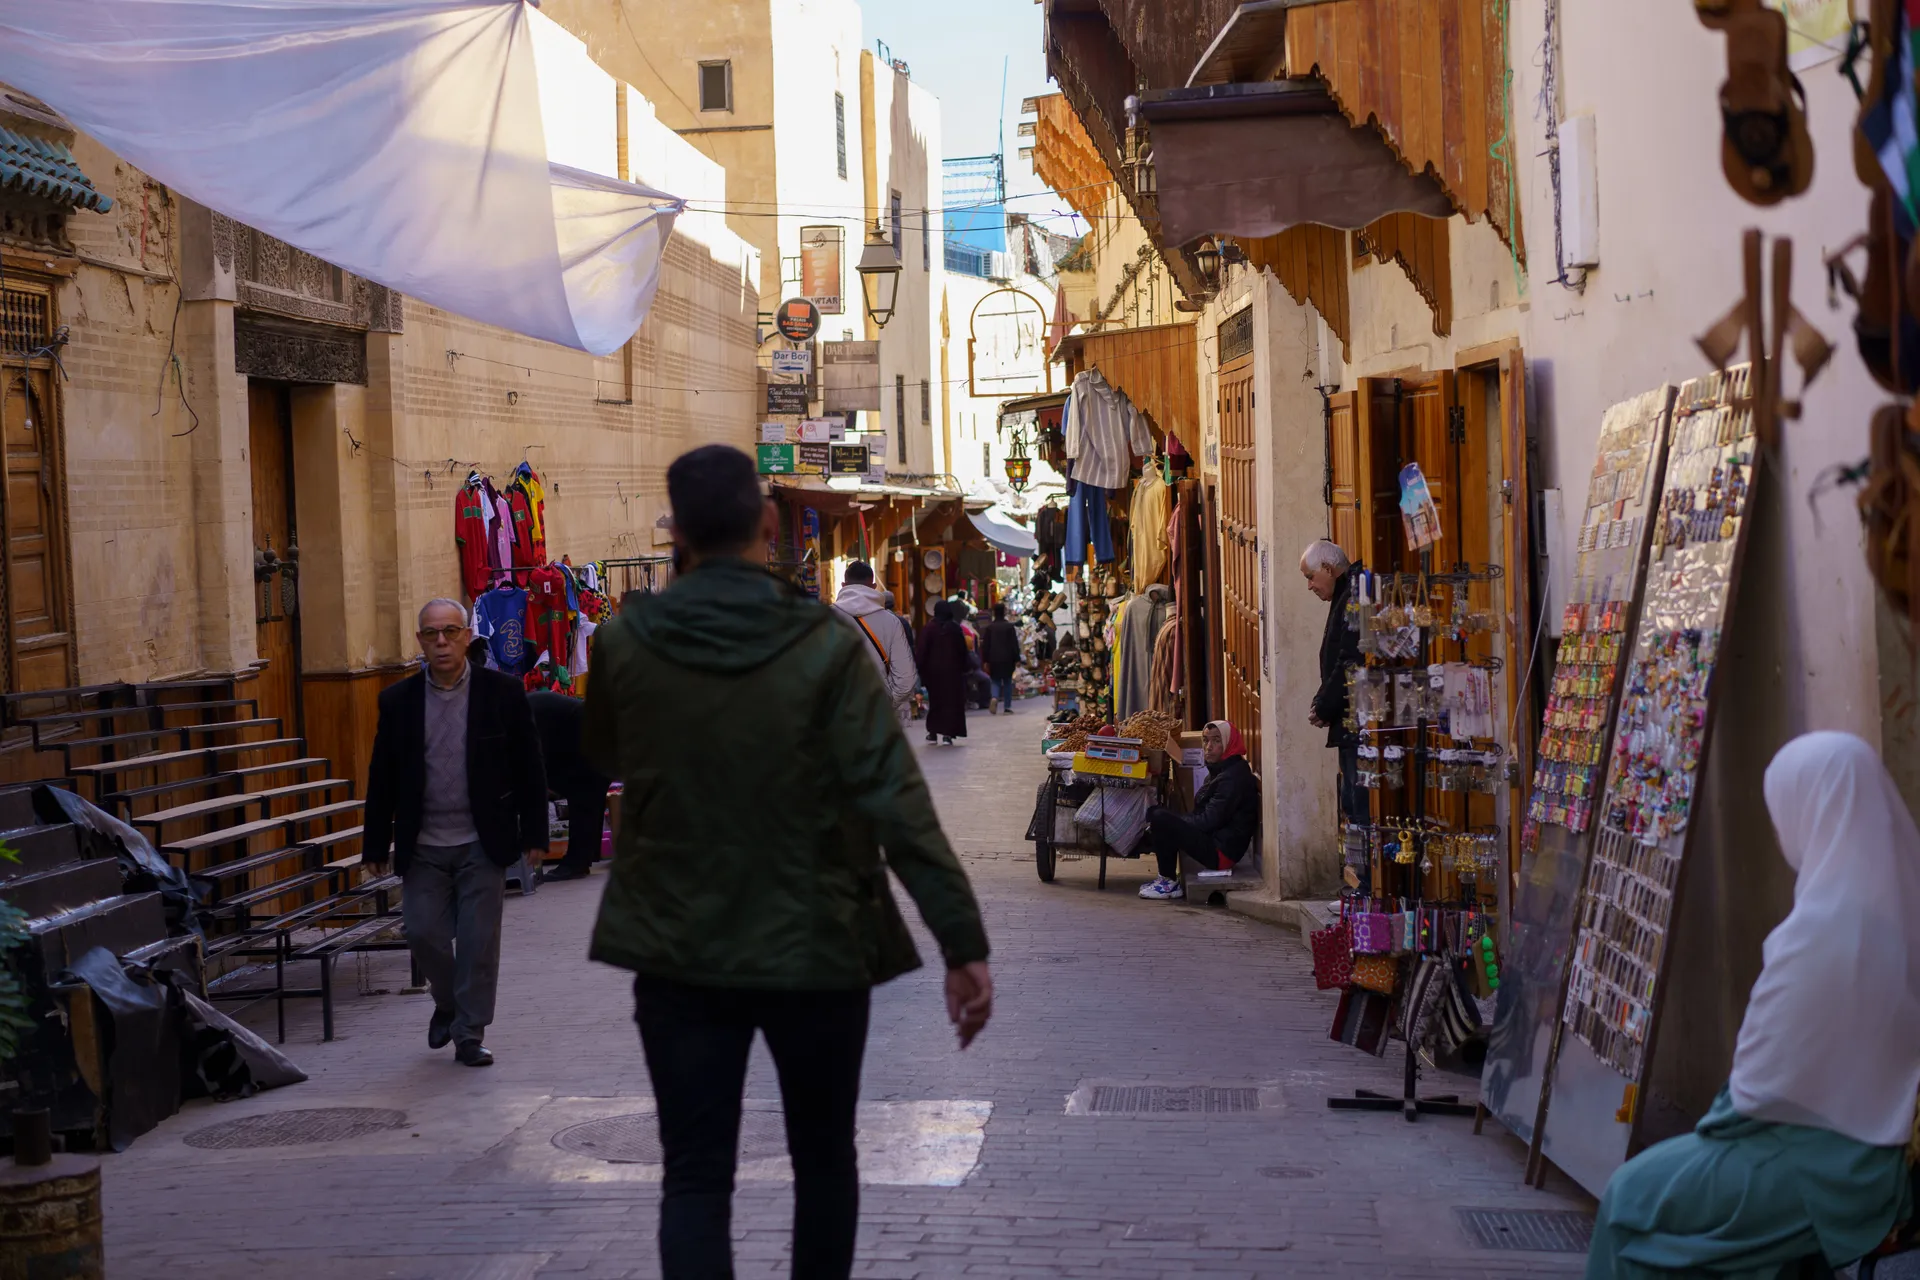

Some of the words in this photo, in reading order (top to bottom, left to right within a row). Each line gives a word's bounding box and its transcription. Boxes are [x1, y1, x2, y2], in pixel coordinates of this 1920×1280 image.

[826, 345, 843, 355] DAR
[774, 352, 788, 360] Dar
[791, 352, 809, 362] Borj
